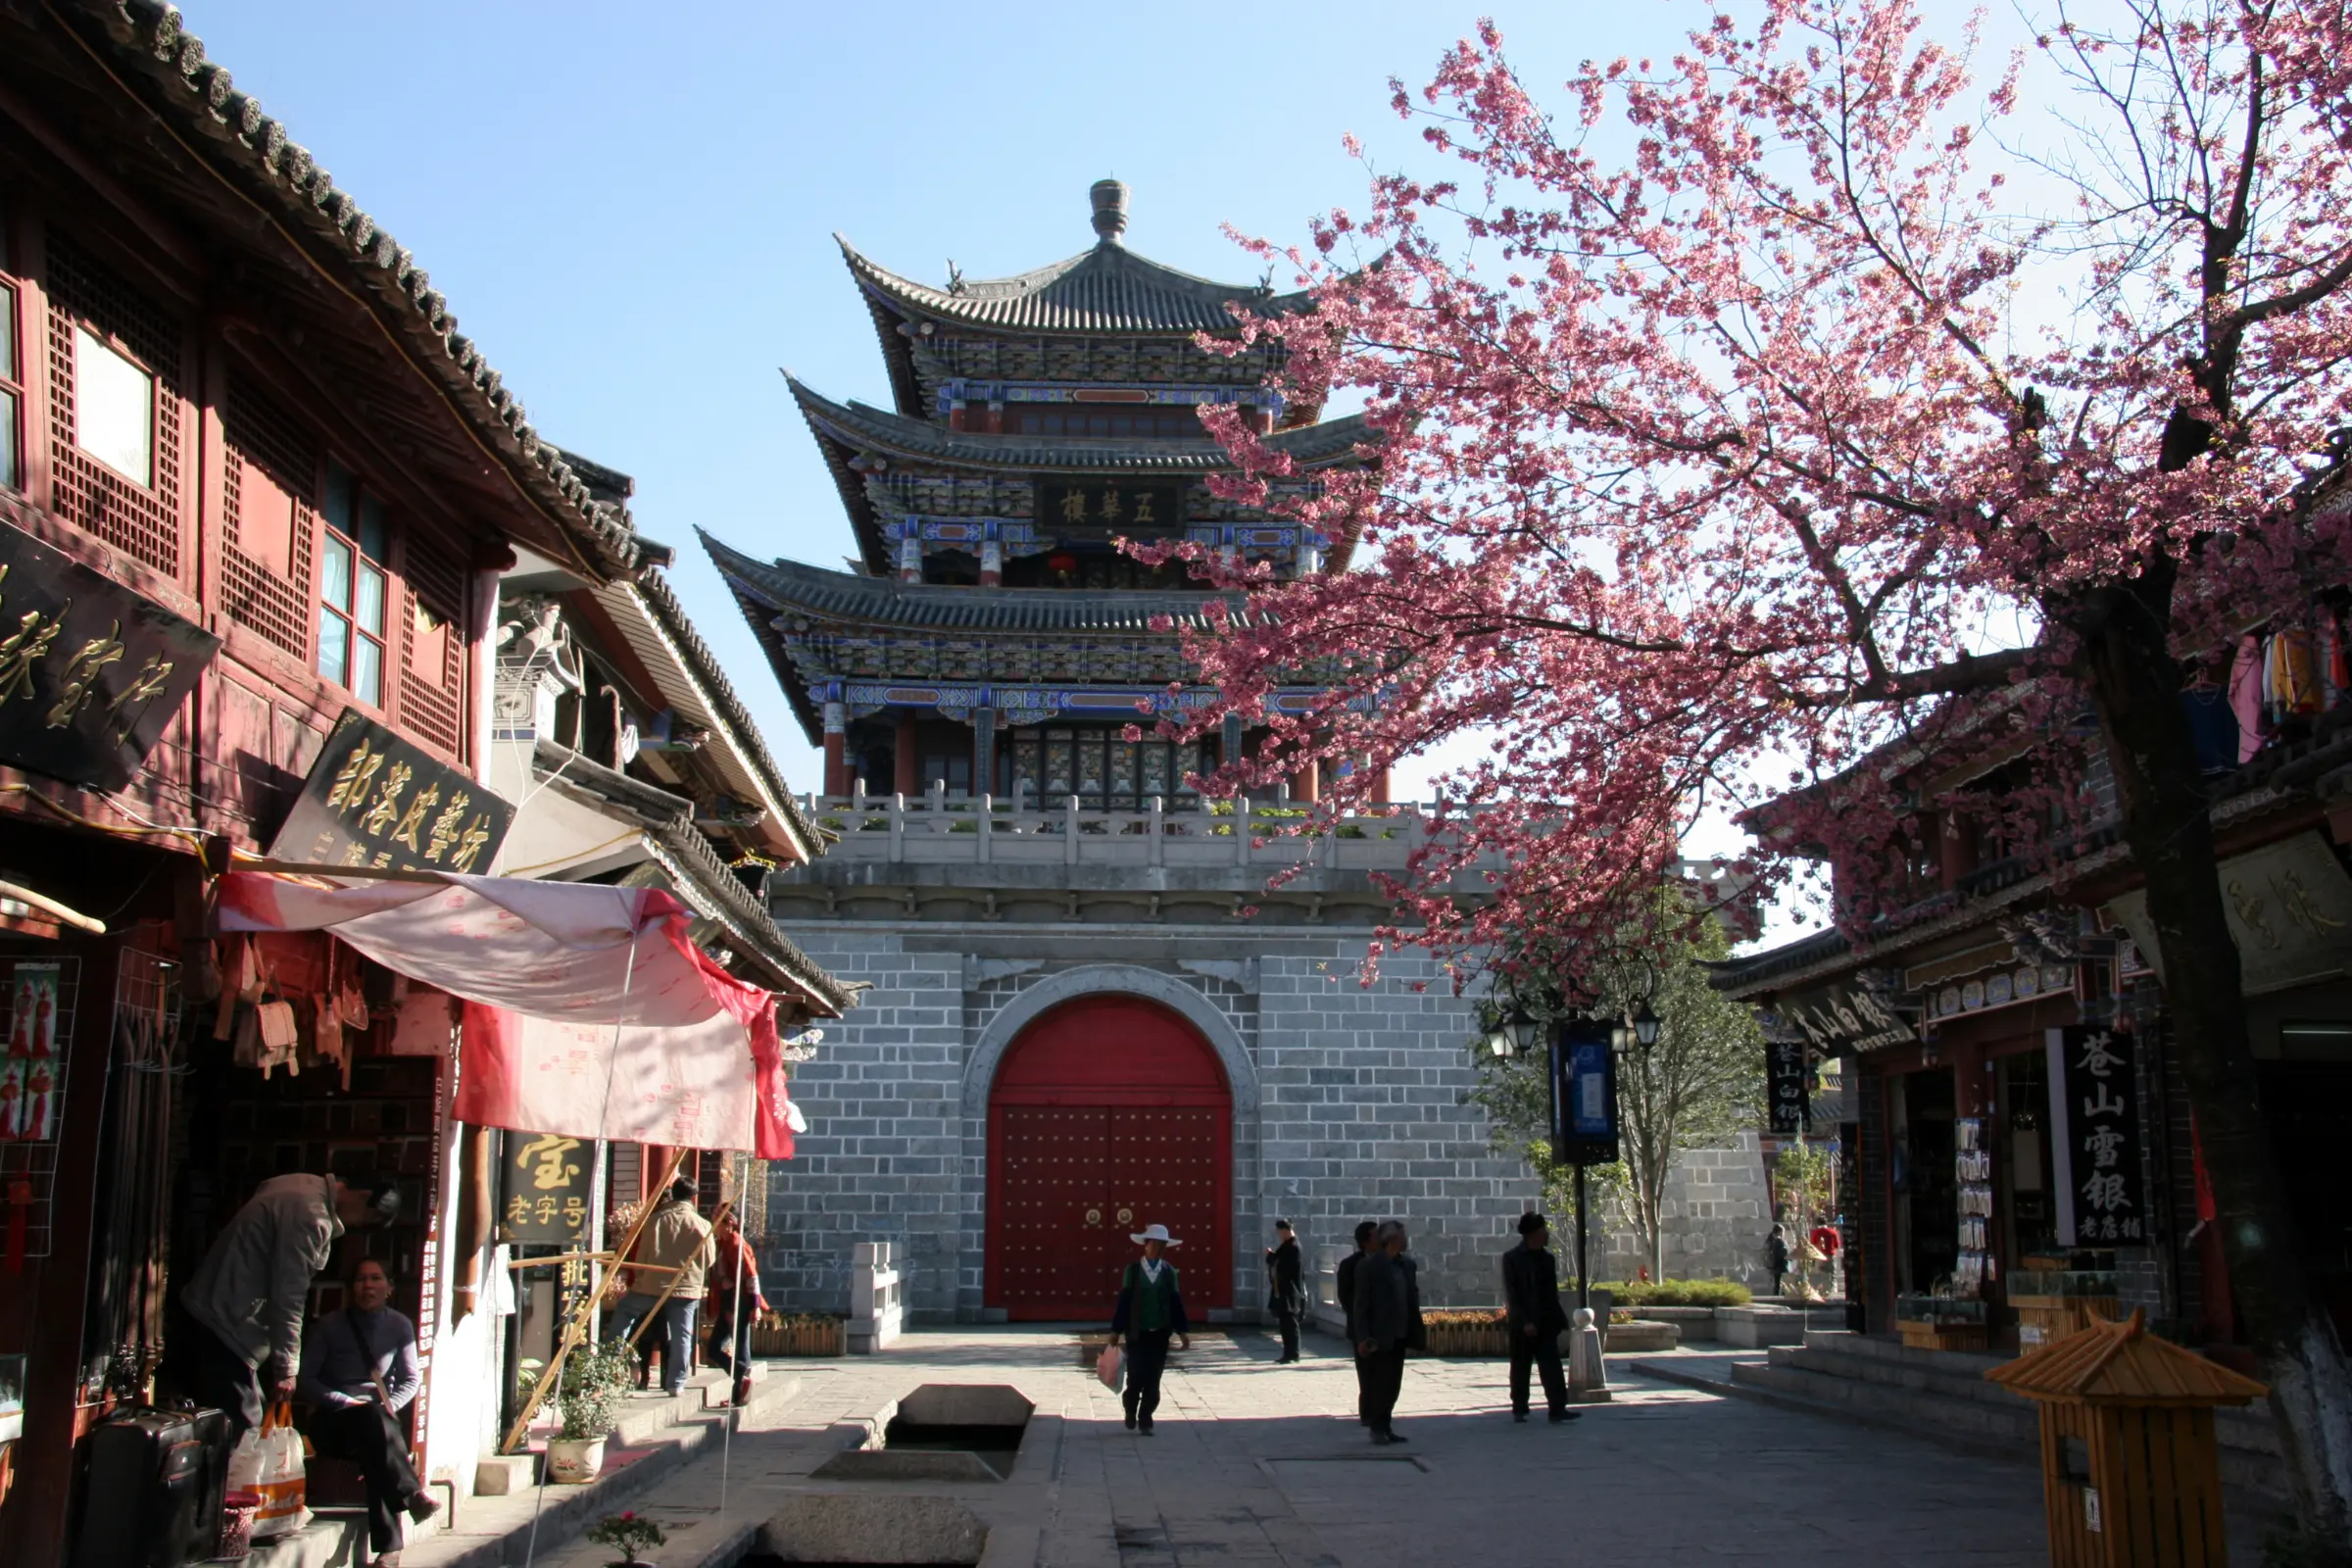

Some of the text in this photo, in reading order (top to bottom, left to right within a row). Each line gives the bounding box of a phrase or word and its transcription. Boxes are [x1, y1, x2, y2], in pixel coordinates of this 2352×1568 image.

[326, 737, 491, 874] 部落皮藝坊
[2075, 1031, 2132, 1212] 苍山雪银
[507, 1194, 586, 1227] 老字号
